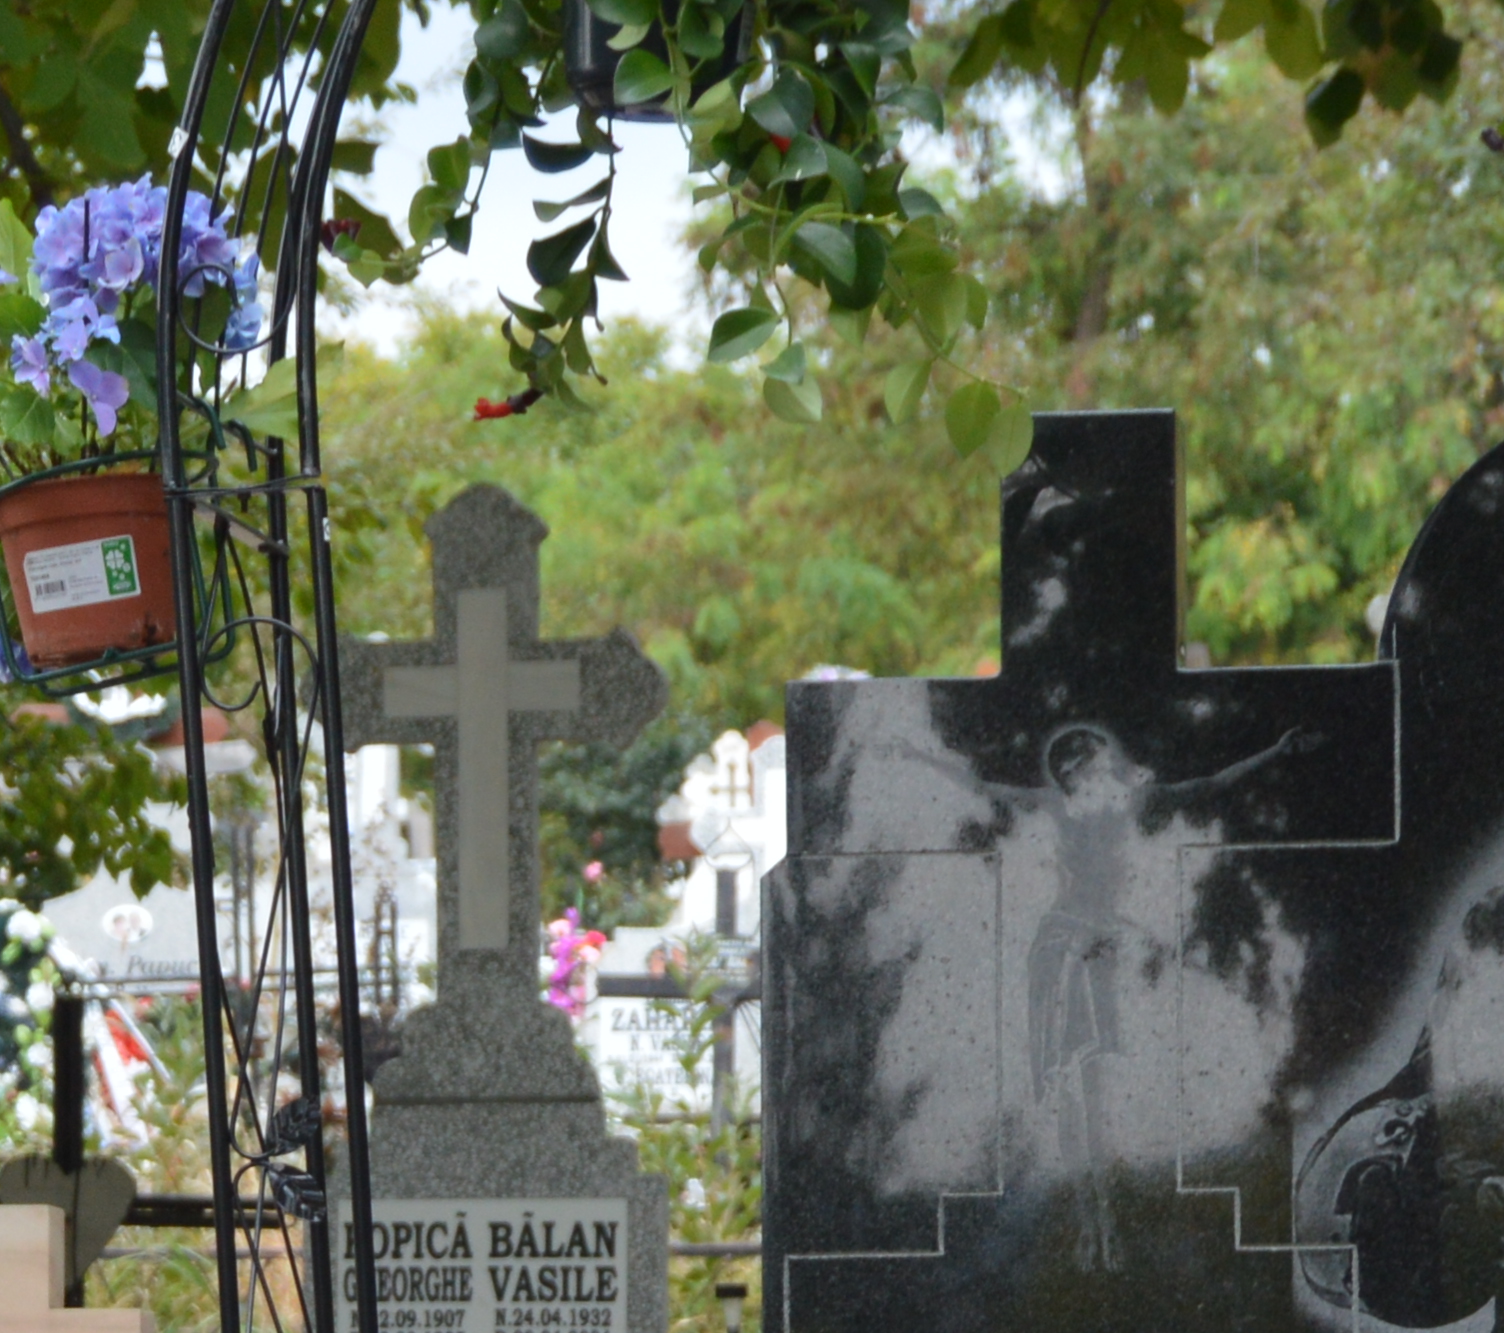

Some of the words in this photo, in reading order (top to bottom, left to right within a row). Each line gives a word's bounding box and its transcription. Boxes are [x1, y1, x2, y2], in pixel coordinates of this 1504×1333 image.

[344, 1266, 474, 1302] GEORGHE
[489, 1266, 619, 1302] VASILE
[495, 1308, 611, 1327] N.24.04.1932
